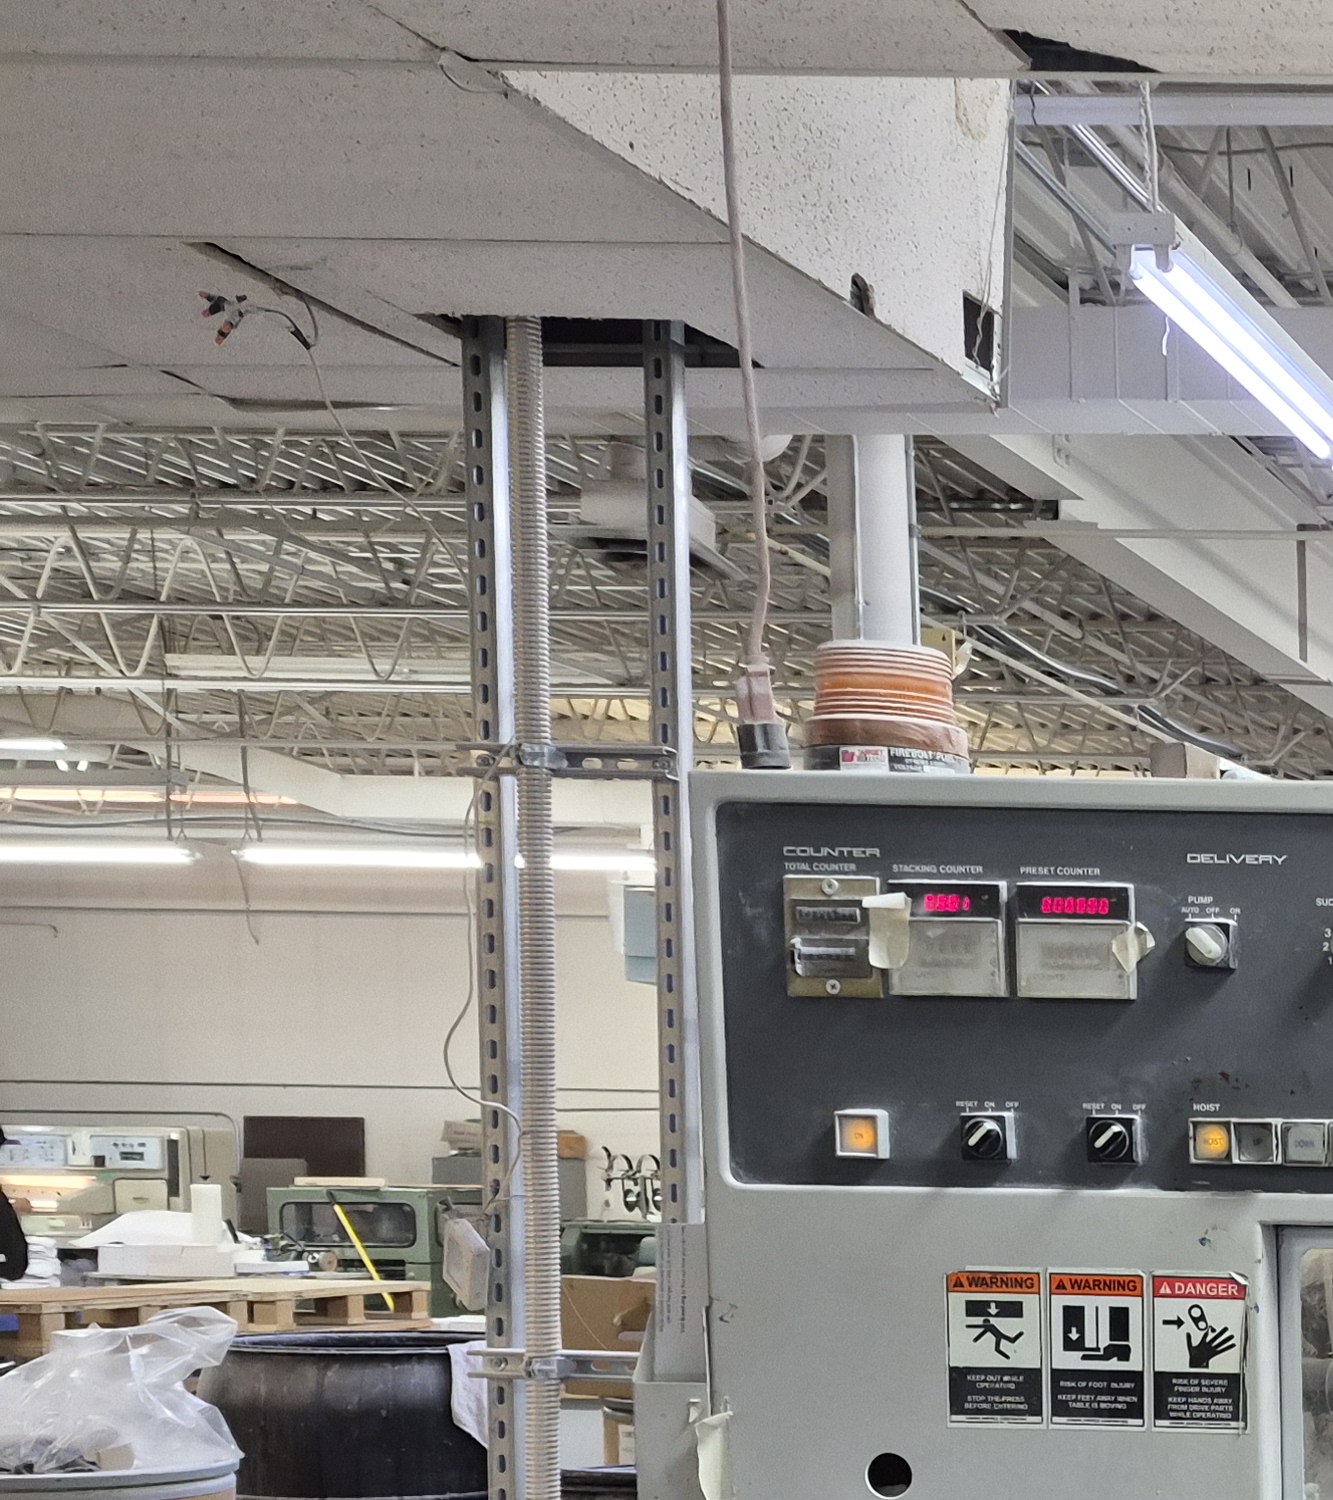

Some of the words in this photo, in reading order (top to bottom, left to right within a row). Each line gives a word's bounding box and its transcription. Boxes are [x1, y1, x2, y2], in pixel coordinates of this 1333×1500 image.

[783, 846, 880, 858] COUNTER
[1186, 853, 1288, 865] DELIVERY
[784, 862, 811, 871] TOTAL
[813, 862, 857, 872] COUNTER
[892, 863, 937, 873] STACKING
[939, 864, 983, 874] COUNTER
[1020, 866, 1055, 875] PRESET
[1057, 867, 1101, 876] COUNTER
[1188, 896, 1213, 904] PUMP
[1324, 929, 1332, 937] 3
[1322, 942, 1330, 951] 2
[1328, 957, 1333, 965] 1
[1193, 1103, 1221, 1111] HOIST
[967, 1275, 1034, 1289] WARNING
[1070, 1278, 1137, 1291] WARNING
[1174, 1282, 1238, 1295] DANGER
